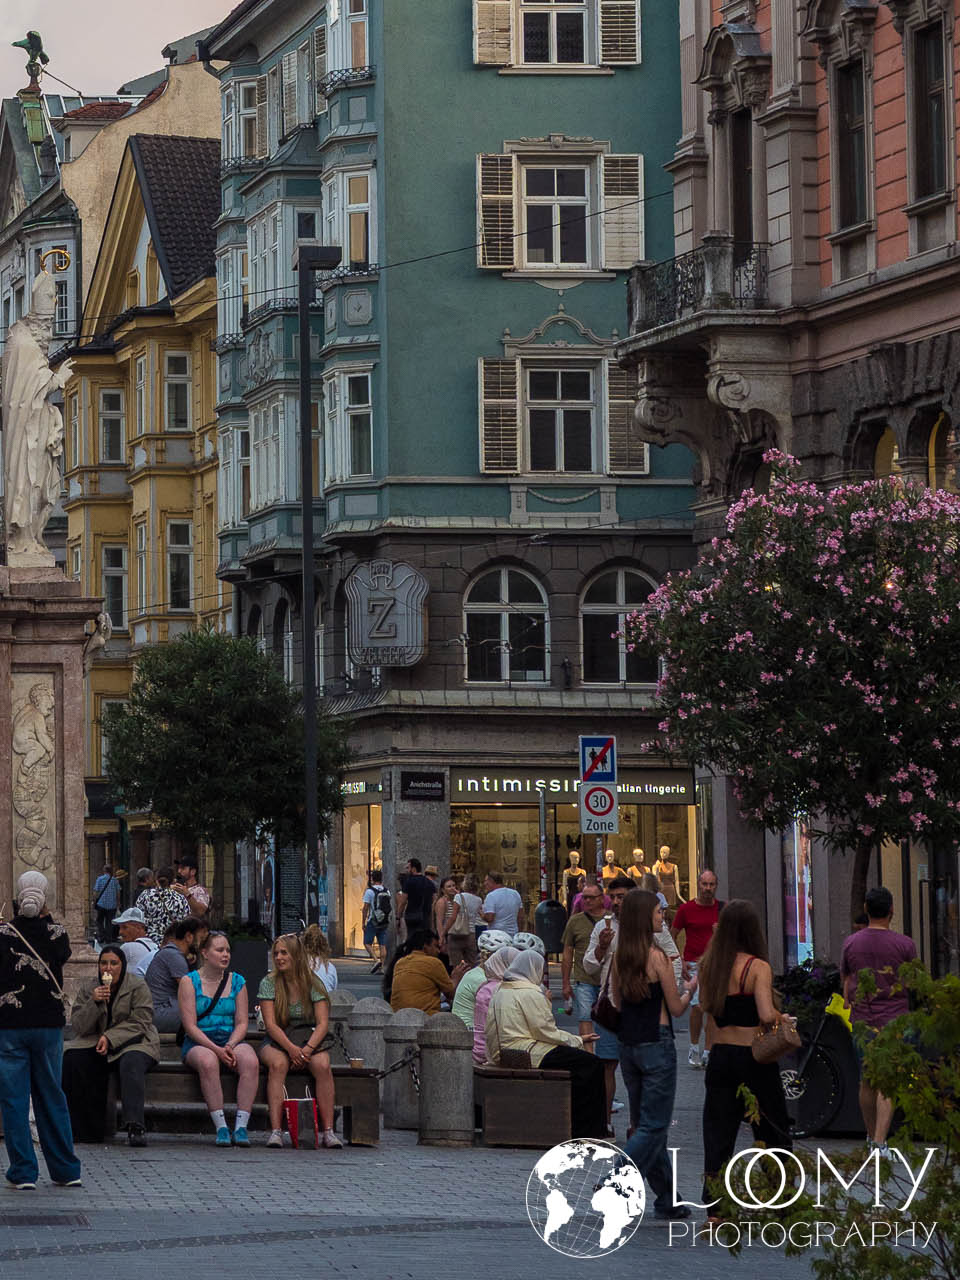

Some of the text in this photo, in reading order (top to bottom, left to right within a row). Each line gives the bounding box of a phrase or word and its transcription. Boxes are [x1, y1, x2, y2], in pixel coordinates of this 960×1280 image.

[367, 596, 397, 639] Z
[616, 783, 686, 795] alian lingerie
[592, 795, 607, 808] 30
[586, 819, 614, 832] Zone
